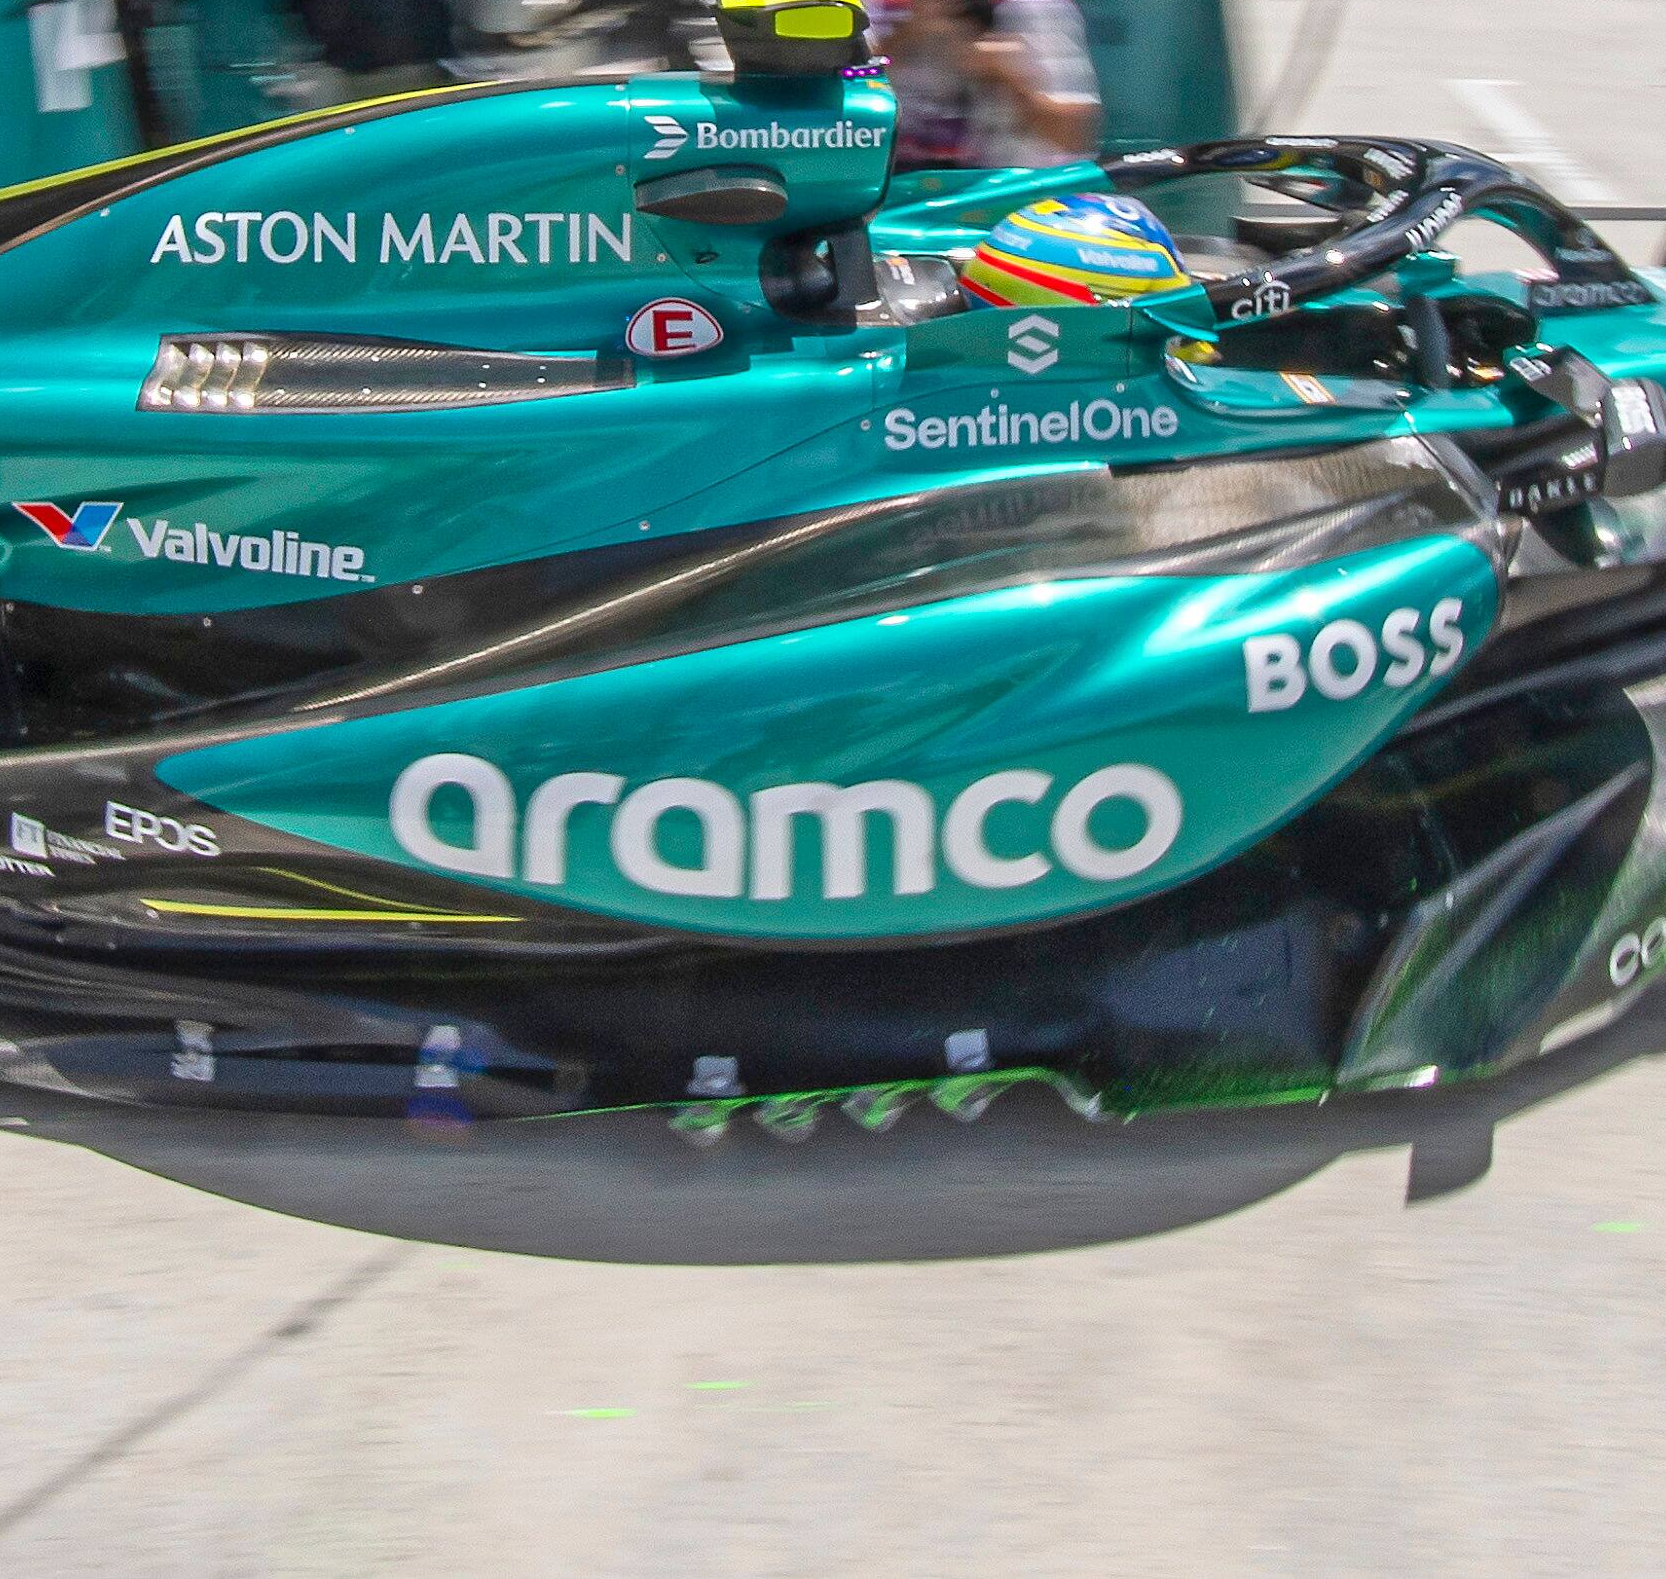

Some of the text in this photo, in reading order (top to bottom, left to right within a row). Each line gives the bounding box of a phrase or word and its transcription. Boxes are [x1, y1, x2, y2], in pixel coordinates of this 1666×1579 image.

[695, 118, 887, 151] Bombardier
[151, 211, 632, 265] ASTON MARTIN
[1230, 280, 1291, 321] citi
[653, 311, 695, 352] E
[884, 398, 1179, 452] SentinelOne
[128, 519, 366, 583] Valvoline
[1244, 597, 1464, 713] BOSS
[106, 800, 221, 857] EPOS
[391, 753, 1183, 901] aramco
